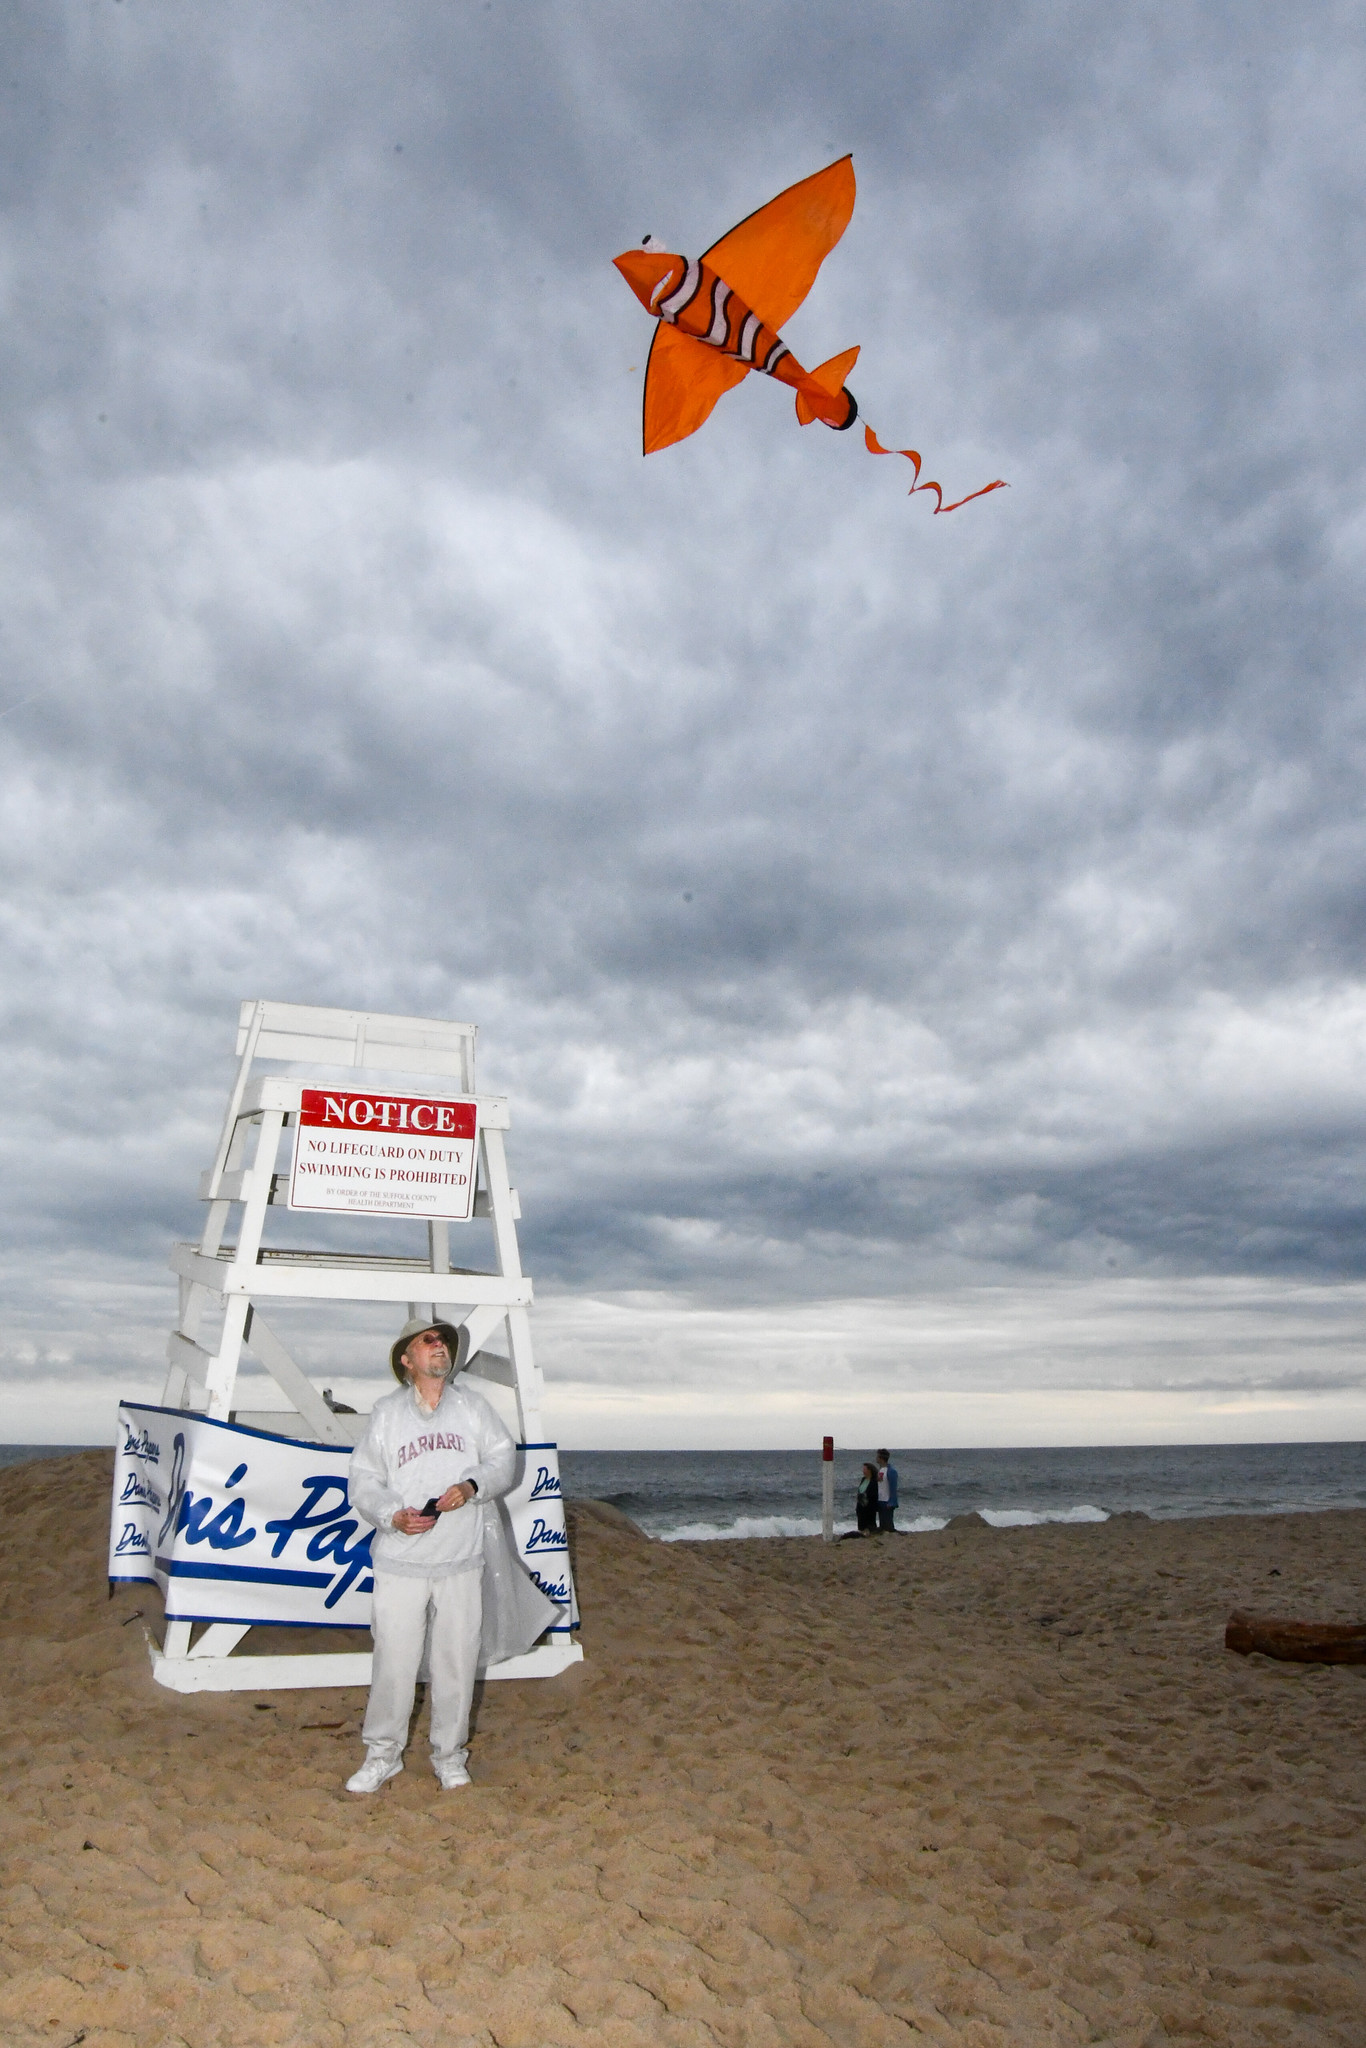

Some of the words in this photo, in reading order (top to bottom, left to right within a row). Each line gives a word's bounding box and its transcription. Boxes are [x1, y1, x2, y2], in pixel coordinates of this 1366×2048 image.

[321, 1096, 456, 1132] NOTICE
[307, 1140, 327, 1153] NO
[330, 1142, 405, 1159] LIFEGUARD
[408, 1148, 426, 1161] ON
[429, 1150, 464, 1163] DUTY
[299, 1163, 371, 1179] SWIMMING
[375, 1168, 386, 1180] IS
[389, 1169, 467, 1186] PROHIBITED
[336, 1188, 358, 1197] ORDER
[383, 1192, 410, 1200] SUFFOLK
[411, 1194, 437, 1202] COUNTY
[348, 1198, 373, 1207] HEALTH
[374, 1200, 414, 1209] DEPARTMENT
[397, 1432, 466, 1469] HARVARD
